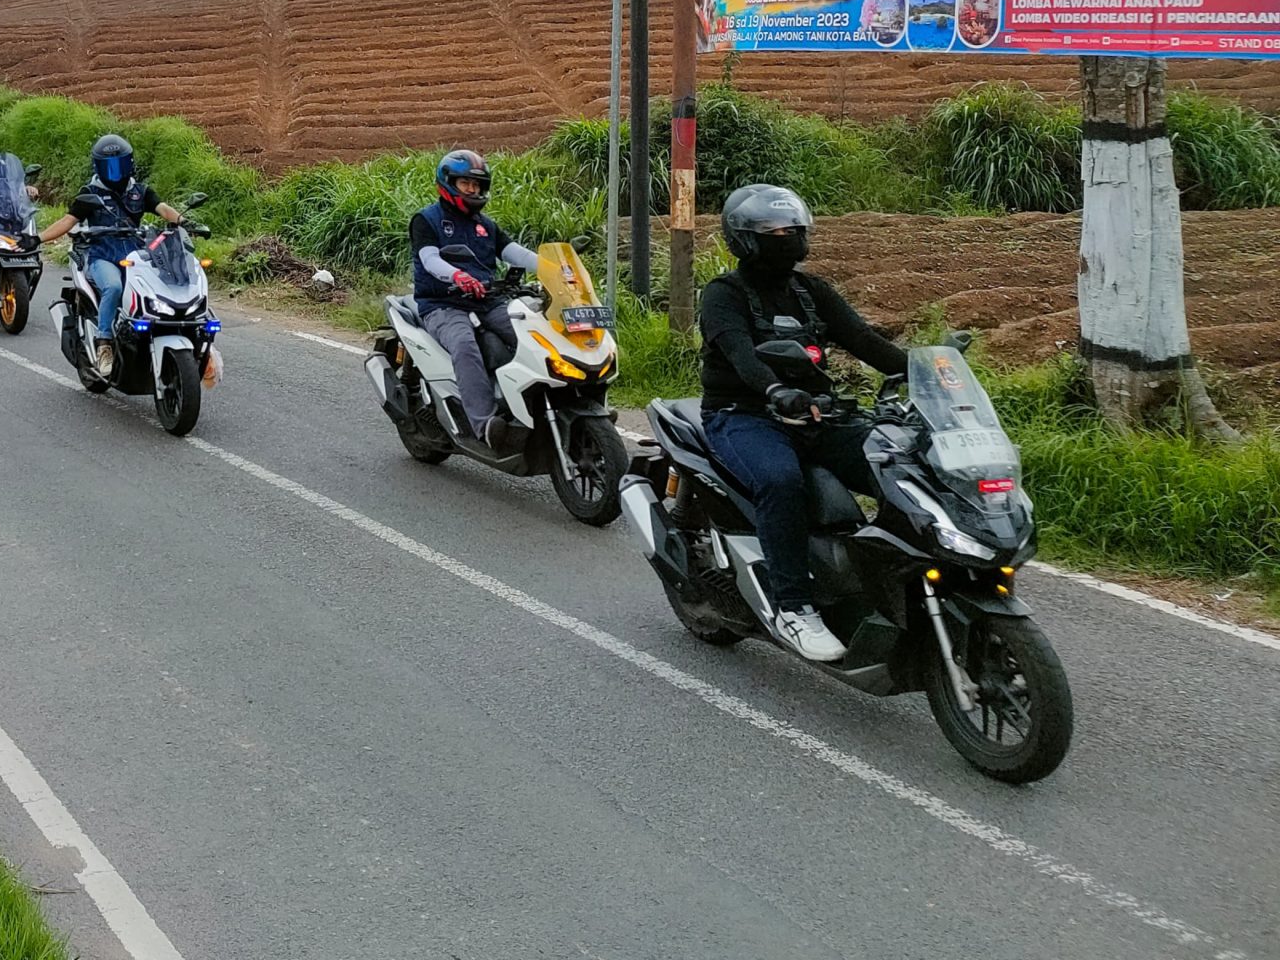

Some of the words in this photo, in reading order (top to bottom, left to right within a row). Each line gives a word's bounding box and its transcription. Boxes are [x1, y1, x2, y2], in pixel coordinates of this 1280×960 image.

[725, 15, 735, 29] 16
[736, 16, 747, 28] sd
[748, 15, 759, 28] 19
[761, 14, 815, 28] November
[816, 12, 850, 27] 2023
[1011, 12, 1051, 24] LOMBA
[1052, 12, 1089, 24] VIDEO
[1090, 12, 1138, 24] KREASI
[1167, 12, 1280, 24] PENGHARGAAN
[732, 32, 752, 41] BALAI
[753, 31, 774, 41] KOTA
[775, 31, 804, 41] AMONG
[806, 31, 825, 41] TANI
[826, 31, 852, 41] KOTA
[853, 31, 880, 41] BATU
[1218, 37, 1262, 48] STAND
